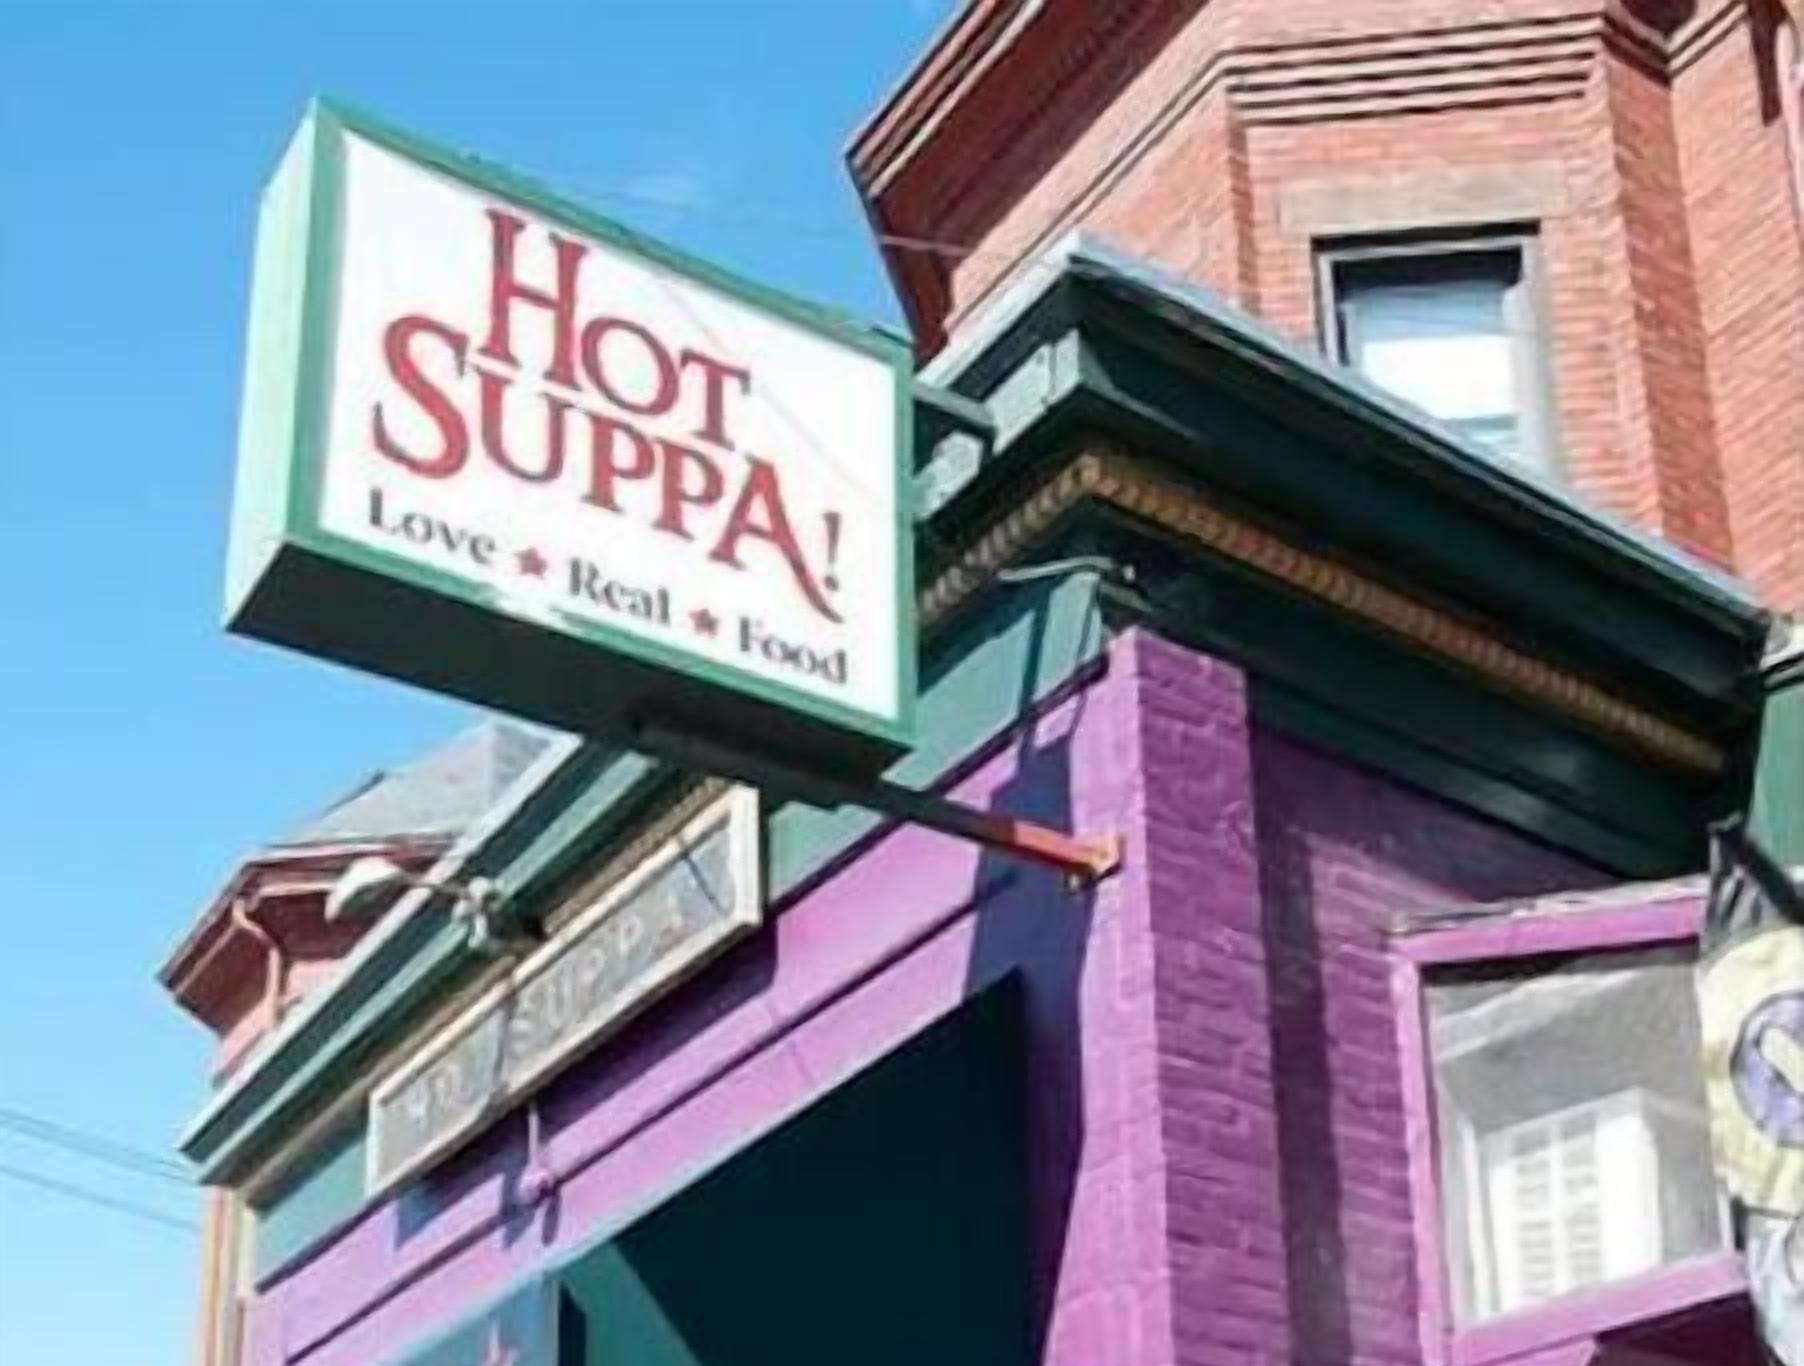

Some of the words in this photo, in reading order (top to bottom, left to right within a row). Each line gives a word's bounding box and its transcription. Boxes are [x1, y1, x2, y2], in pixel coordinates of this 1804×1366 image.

[482, 208, 750, 450] HOT
[369, 488, 496, 565] Love
[569, 558, 671, 625] Real
[738, 617, 847, 685] Food
[371, 315, 844, 623] SUPPA!
